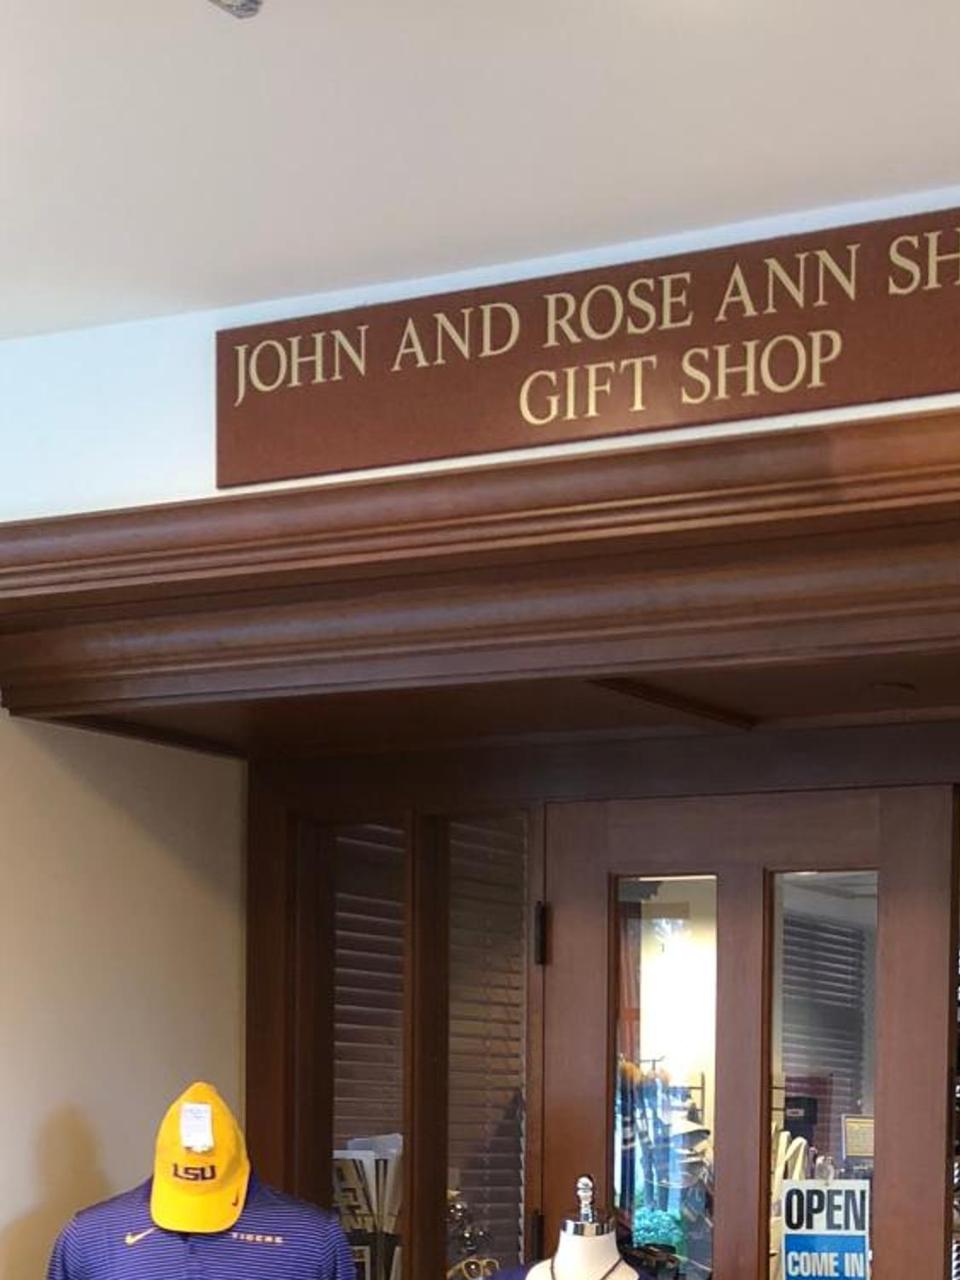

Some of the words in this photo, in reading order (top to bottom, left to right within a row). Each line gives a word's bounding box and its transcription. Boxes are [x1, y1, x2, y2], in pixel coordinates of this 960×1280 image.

[234, 325, 369, 407] JOHN
[391, 302, 520, 372] AND
[543, 272, 694, 348] ROSE
[715, 244, 862, 322] ANN
[519, 356, 657, 425] GIFT
[681, 329, 843, 405] SHOP
[172, 1162, 218, 1181] LSU
[784, 1188, 867, 1231] OPEN
[786, 1251, 840, 1277] COME
[844, 1252, 864, 1277] IN
